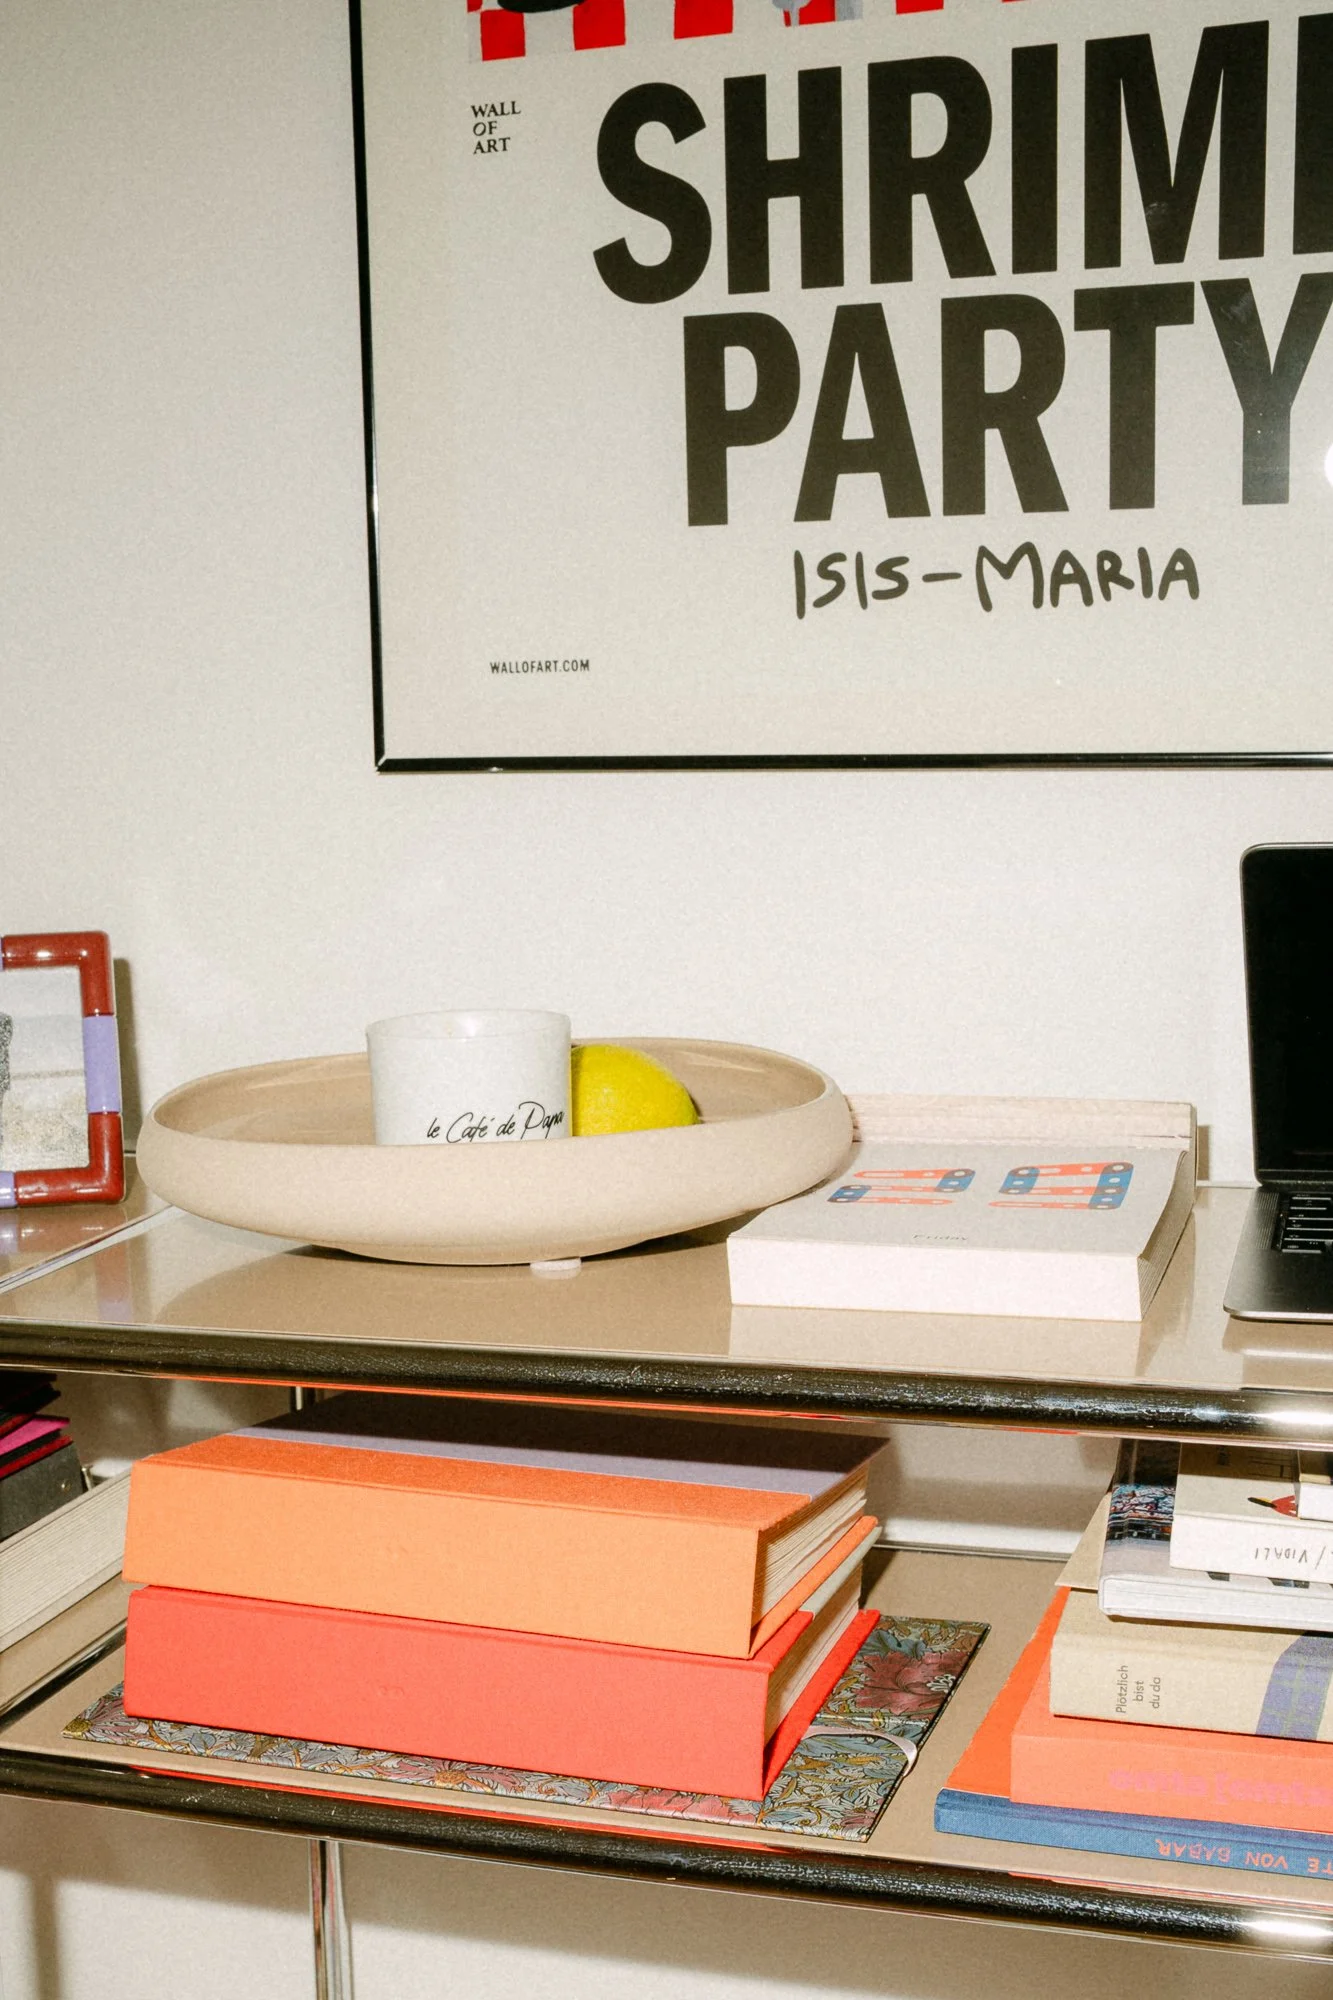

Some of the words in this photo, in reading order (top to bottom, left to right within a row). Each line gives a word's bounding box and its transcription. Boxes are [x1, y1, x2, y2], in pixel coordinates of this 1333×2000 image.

[471, 101, 521, 118] WALL
[473, 121, 497, 136] OF
[474, 137, 511, 154] ART
[683, 272, 1333, 526] PARTY
[490, 659, 590, 674] WALLOFART.COM
[426, 1117, 441, 1138] le
[446, 1112, 495, 1143] Café
[496, 1114, 516, 1137] de
[518, 1101, 566, 1140] Papa
[1115, 1665, 1128, 1713] Plötzlich
[1132, 1680, 1144, 1702] bist
[1149, 1677, 1161, 1692] da
[1149, 1694, 1160, 1709] du
[1155, 1839, 1231, 1863] BABAR
[1245, 1851, 1289, 1870] VON
